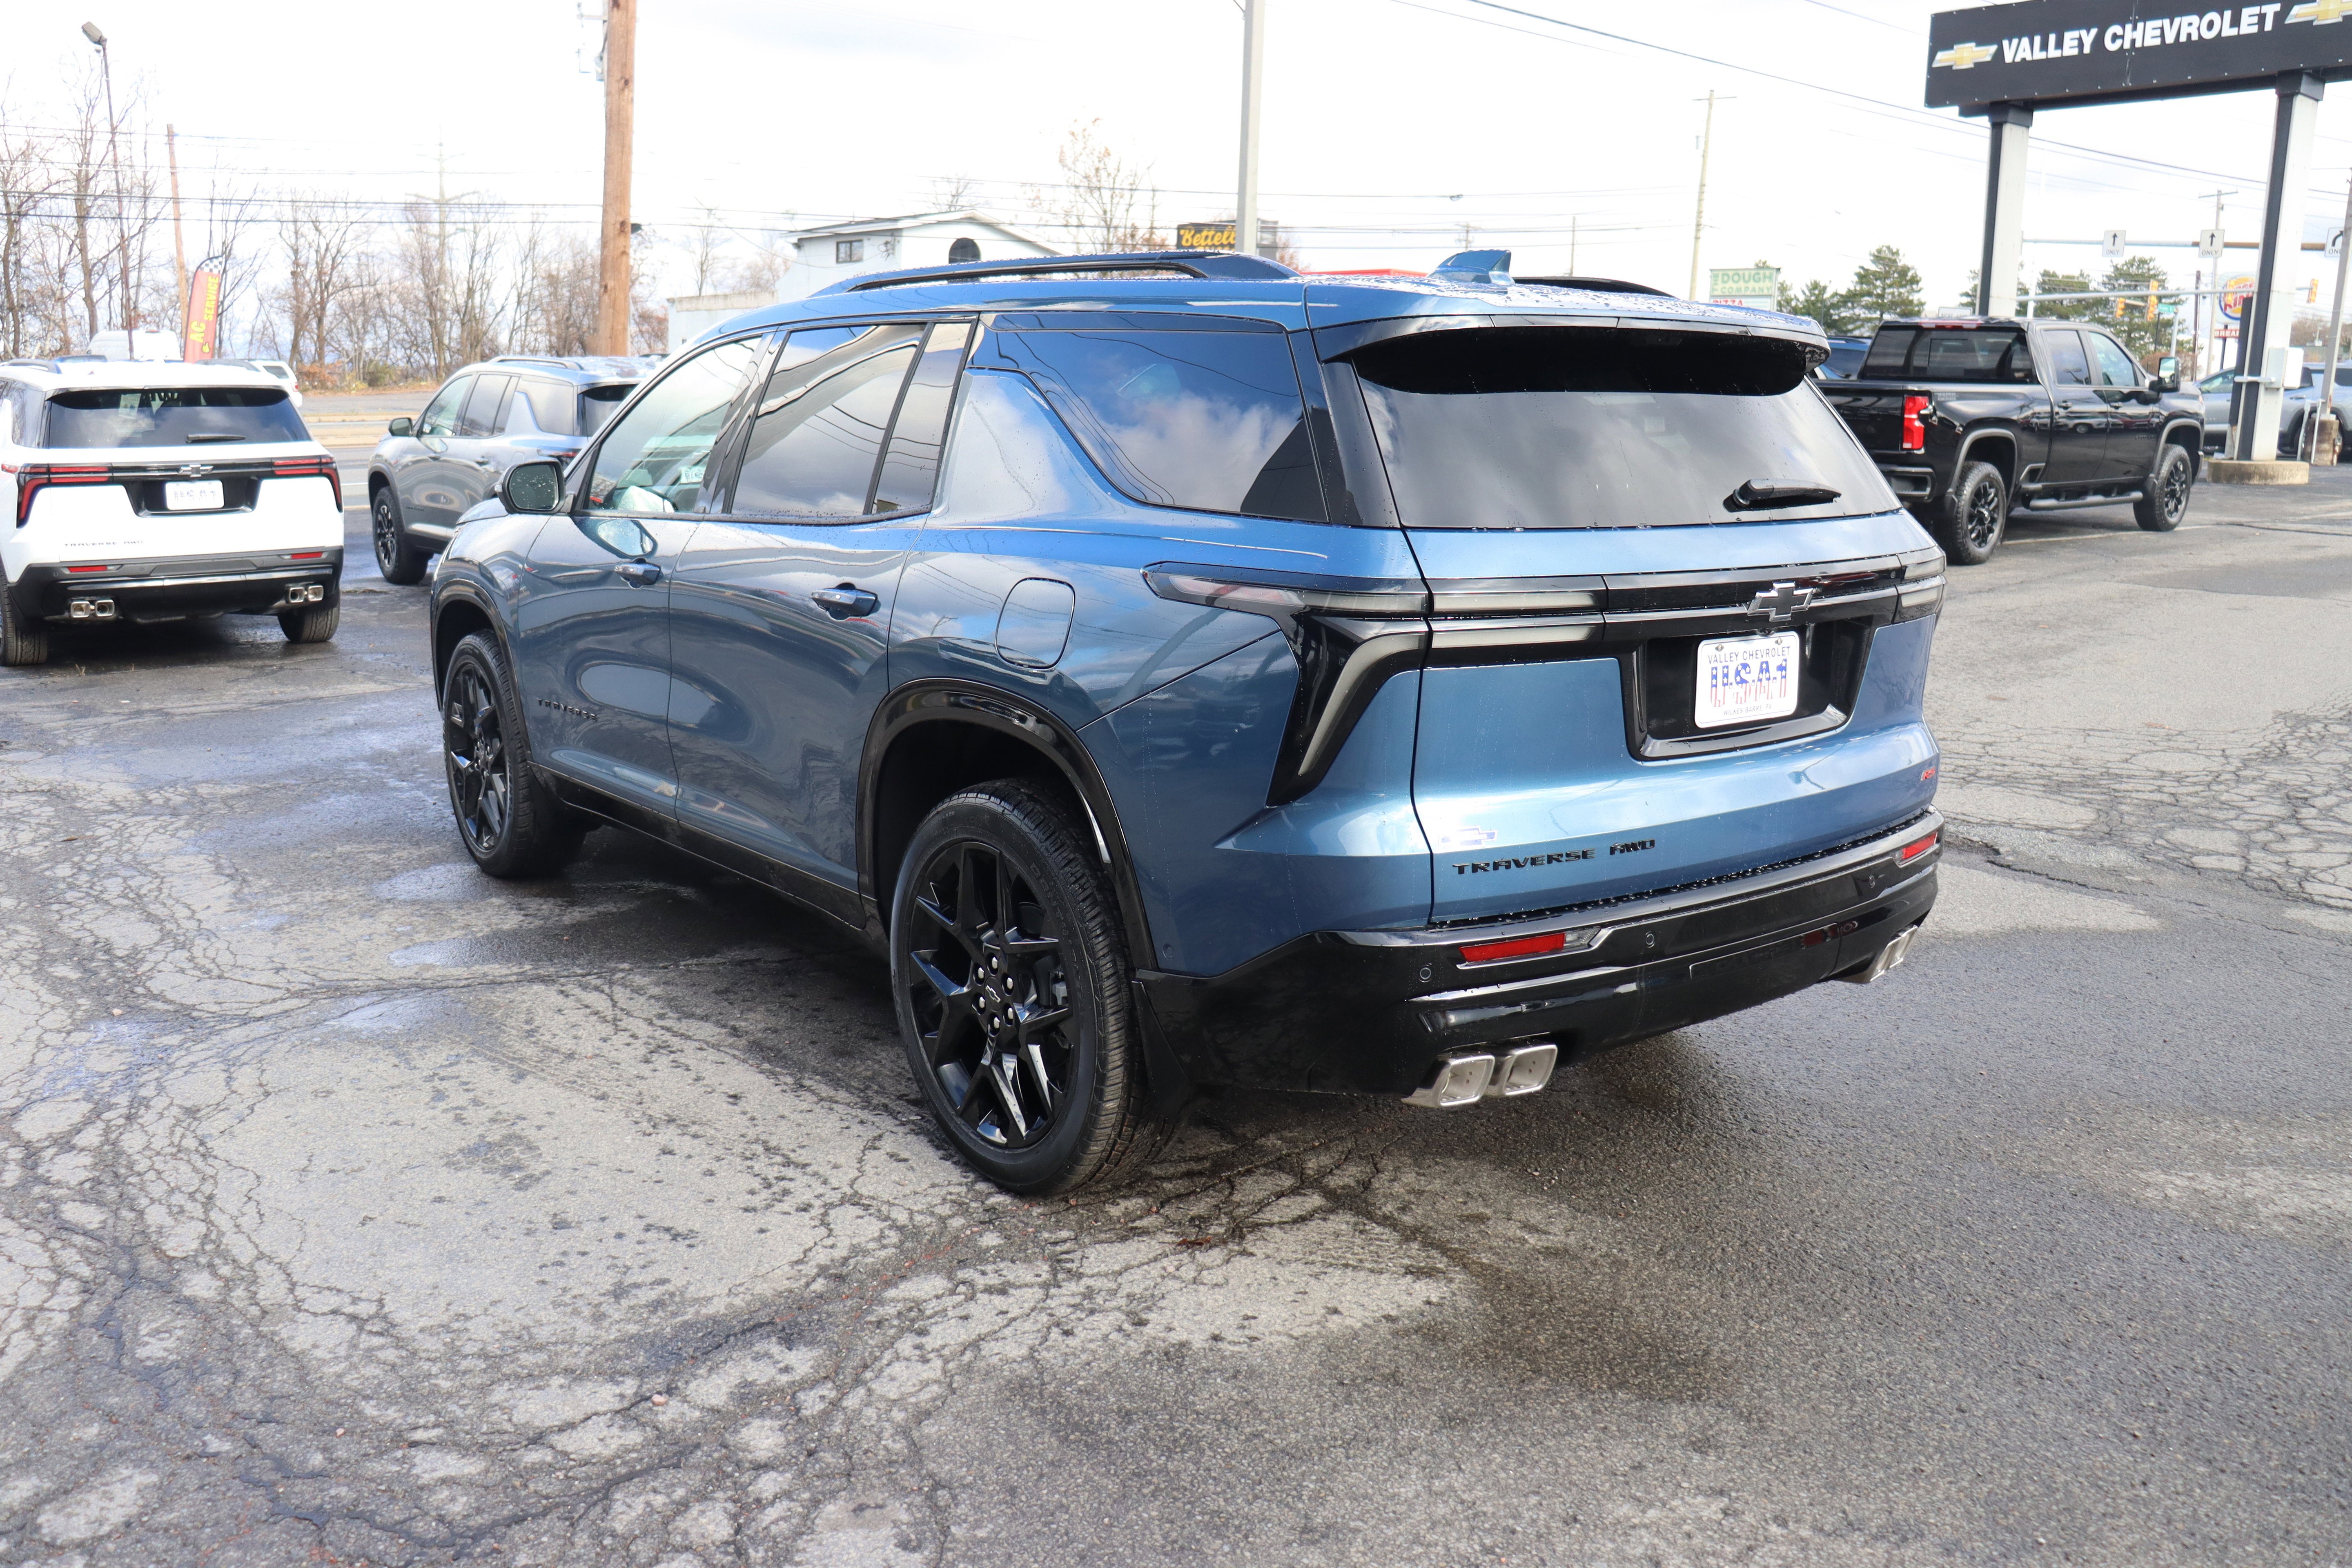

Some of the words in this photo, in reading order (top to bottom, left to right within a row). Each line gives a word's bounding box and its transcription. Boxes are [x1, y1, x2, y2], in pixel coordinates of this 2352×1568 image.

[2002, 29, 2098, 63] VALLEY
[2104, 3, 2281, 50] CHEVROLET
[1722, 272, 1773, 283] DOUGH
[204, 275, 219, 321] SERVICE
[189, 321, 206, 343] AC
[1708, 652, 1739, 664] VALLEY
[1742, 646, 1790, 660] CHEVROLET
[537, 698, 598, 722] TRAVERSE
[1452, 847, 1596, 875] TRAVERSE
[1610, 838, 1655, 855] AWD
